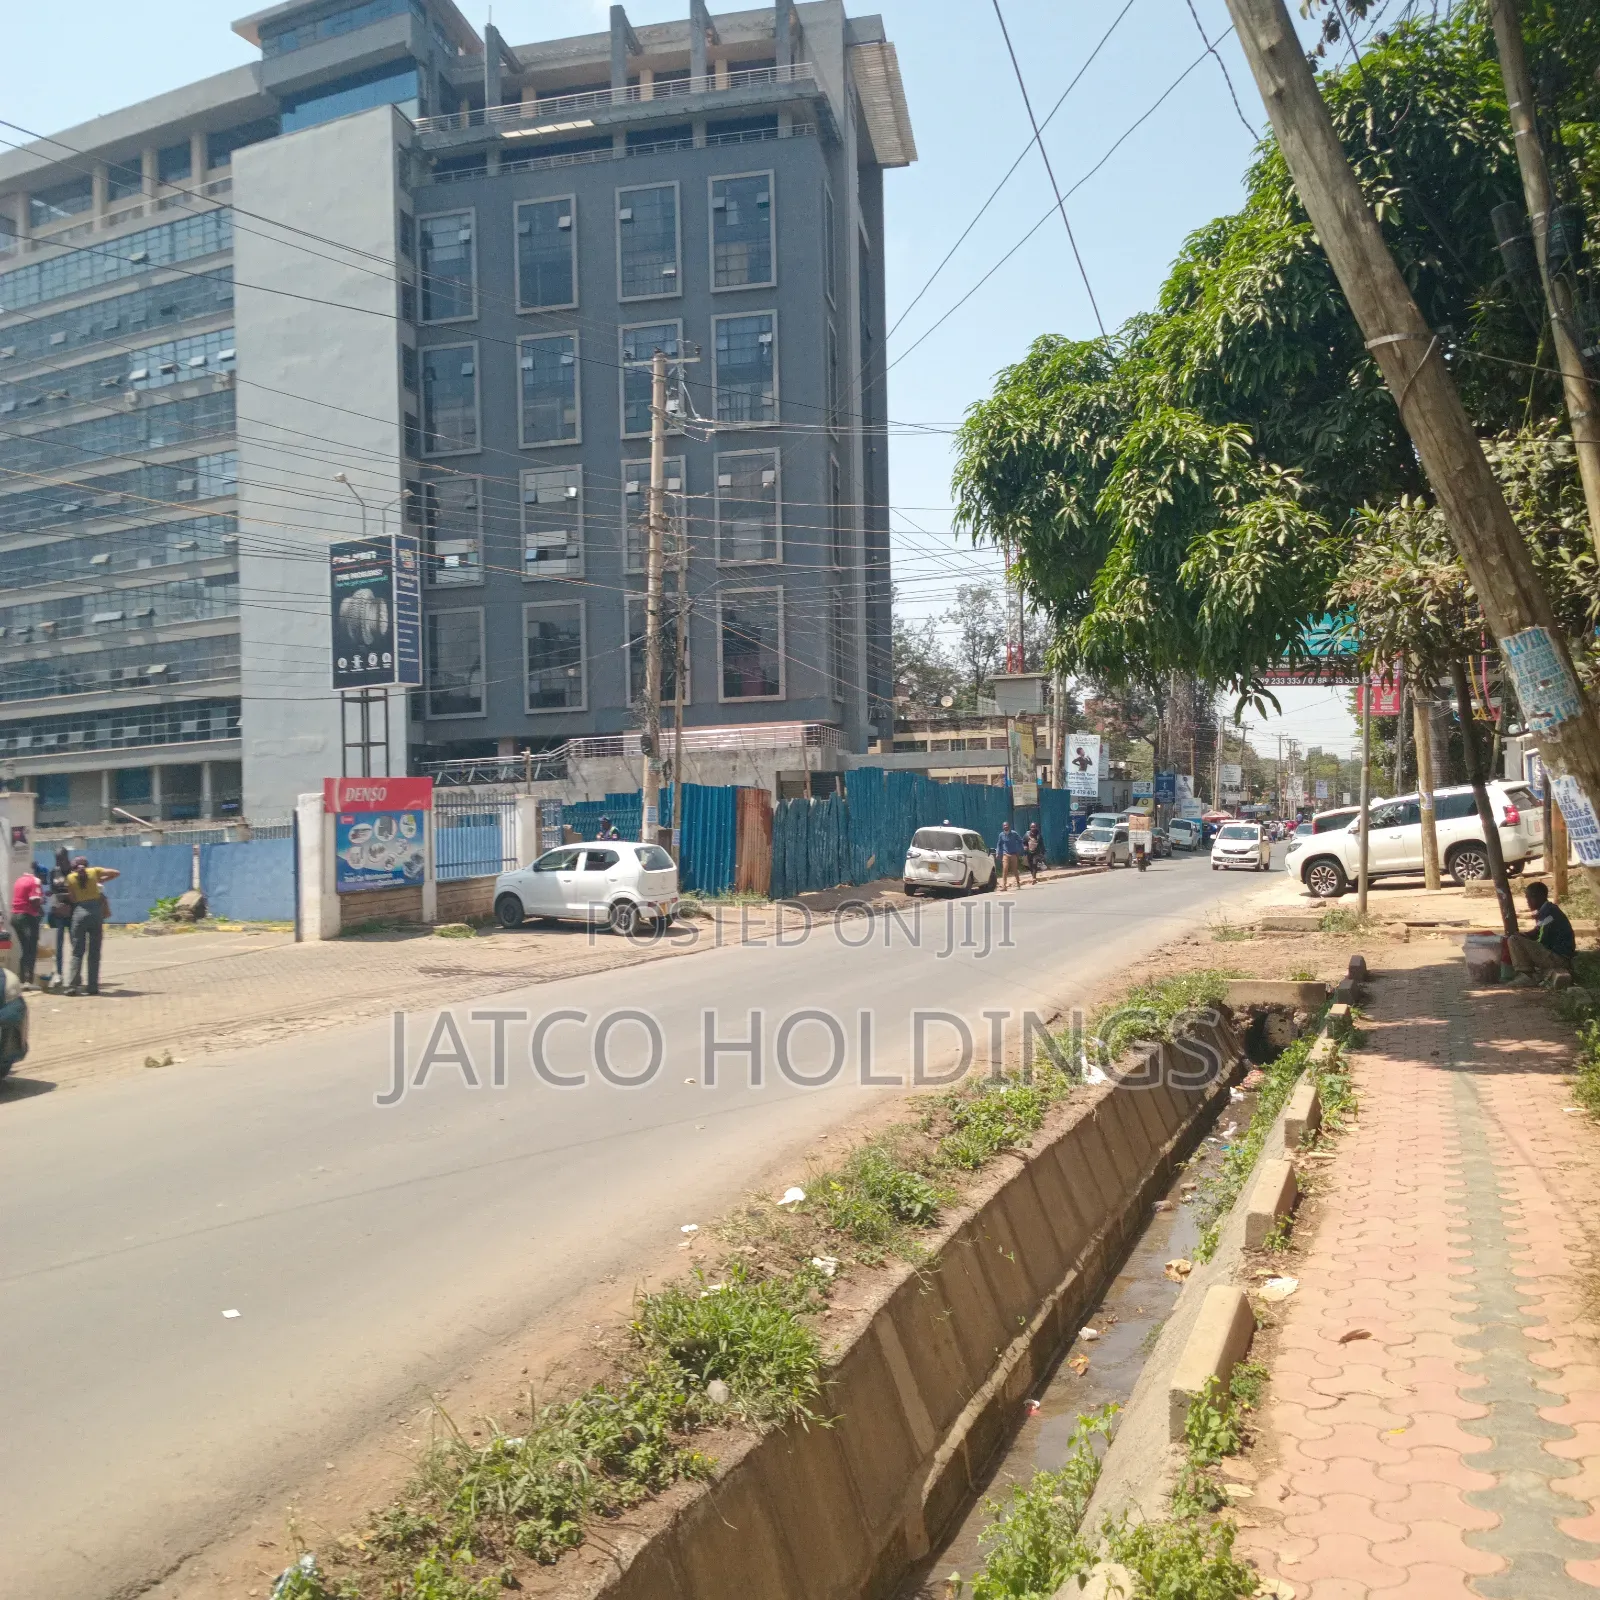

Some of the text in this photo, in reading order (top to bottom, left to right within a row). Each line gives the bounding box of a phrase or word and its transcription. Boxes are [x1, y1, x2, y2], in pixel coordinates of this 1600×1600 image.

[345, 787, 387, 802] DENSO
[1564, 808, 1590, 818] SSUES
[1566, 816, 1594, 828] OOSTING
[1574, 825, 1597, 836] RING
